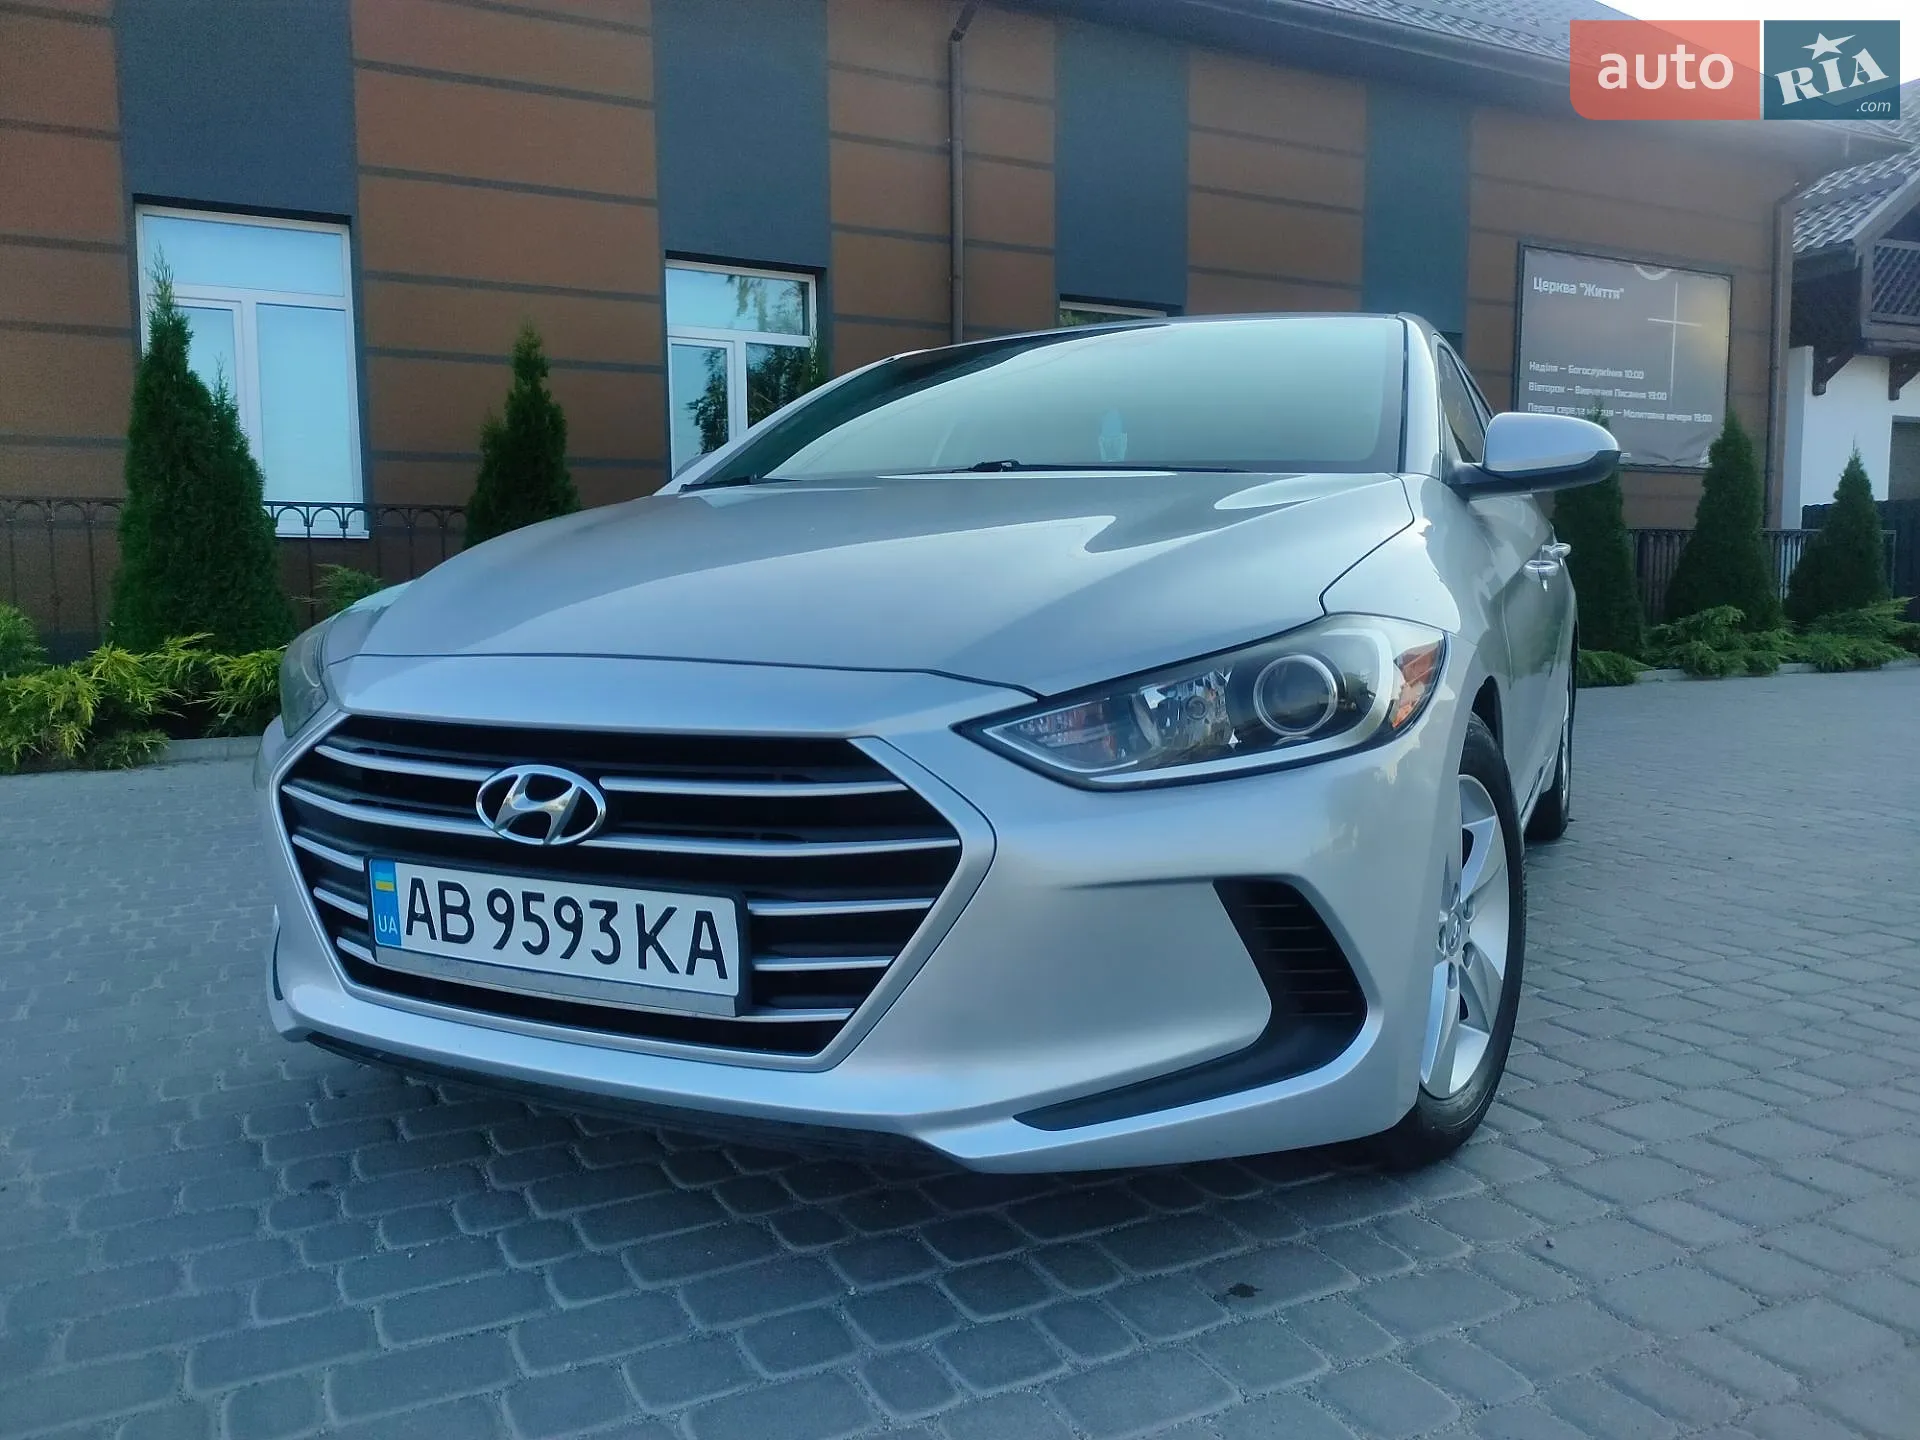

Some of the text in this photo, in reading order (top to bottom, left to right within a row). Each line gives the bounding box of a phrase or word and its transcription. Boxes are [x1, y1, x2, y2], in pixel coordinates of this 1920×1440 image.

[1533, 277, 1625, 300] Церква "Життя"
[1529, 361, 1559, 373] Неділя
[1624, 369, 1645, 380] 10:00
[1528, 381, 1566, 395] Вівторок
[1614, 388, 1647, 399] Писання
[378, 913, 399, 935] UA
[405, 876, 729, 980] AB 9593 KA
